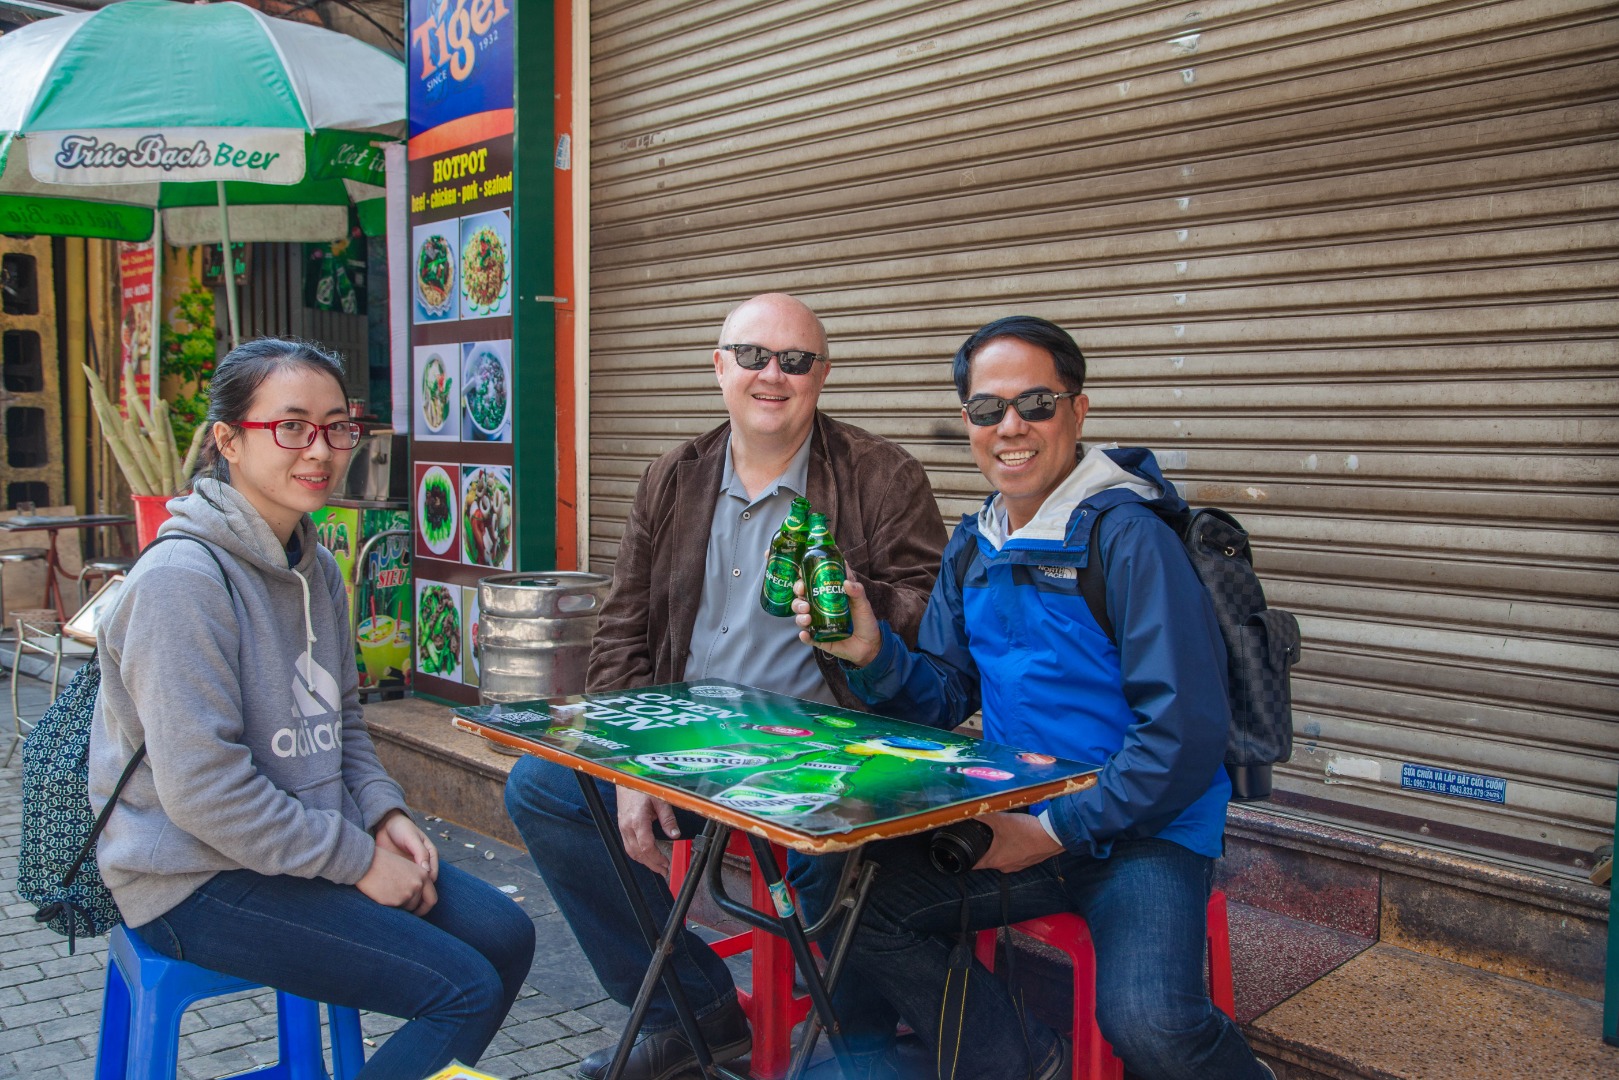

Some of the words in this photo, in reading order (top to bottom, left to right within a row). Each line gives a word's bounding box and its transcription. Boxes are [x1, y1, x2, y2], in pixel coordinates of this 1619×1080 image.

[412, 0, 510, 82] Tiger
[479, 30, 499, 51] 1932
[426, 70, 448, 92] SINCE
[213, 142, 280, 170] Beer
[432, 147, 488, 184] HOTPOT
[411, 192, 426, 213] beef
[430, 187, 457, 209] chicken
[461, 180, 478, 204] pork
[483, 171, 513, 197] seafood
[766, 570, 794, 588] SPECIA
[1038, 565, 1065, 574] NORTH
[1044, 571, 1063, 579] FACE
[813, 585, 847, 597] SPECIA
[549, 701, 676, 731] FUN
[592, 696, 708, 726] FOR
[636, 692, 749, 719] OPEN
[558, 728, 631, 750] TUBORG
[645, 755, 741, 766] TUBORG
